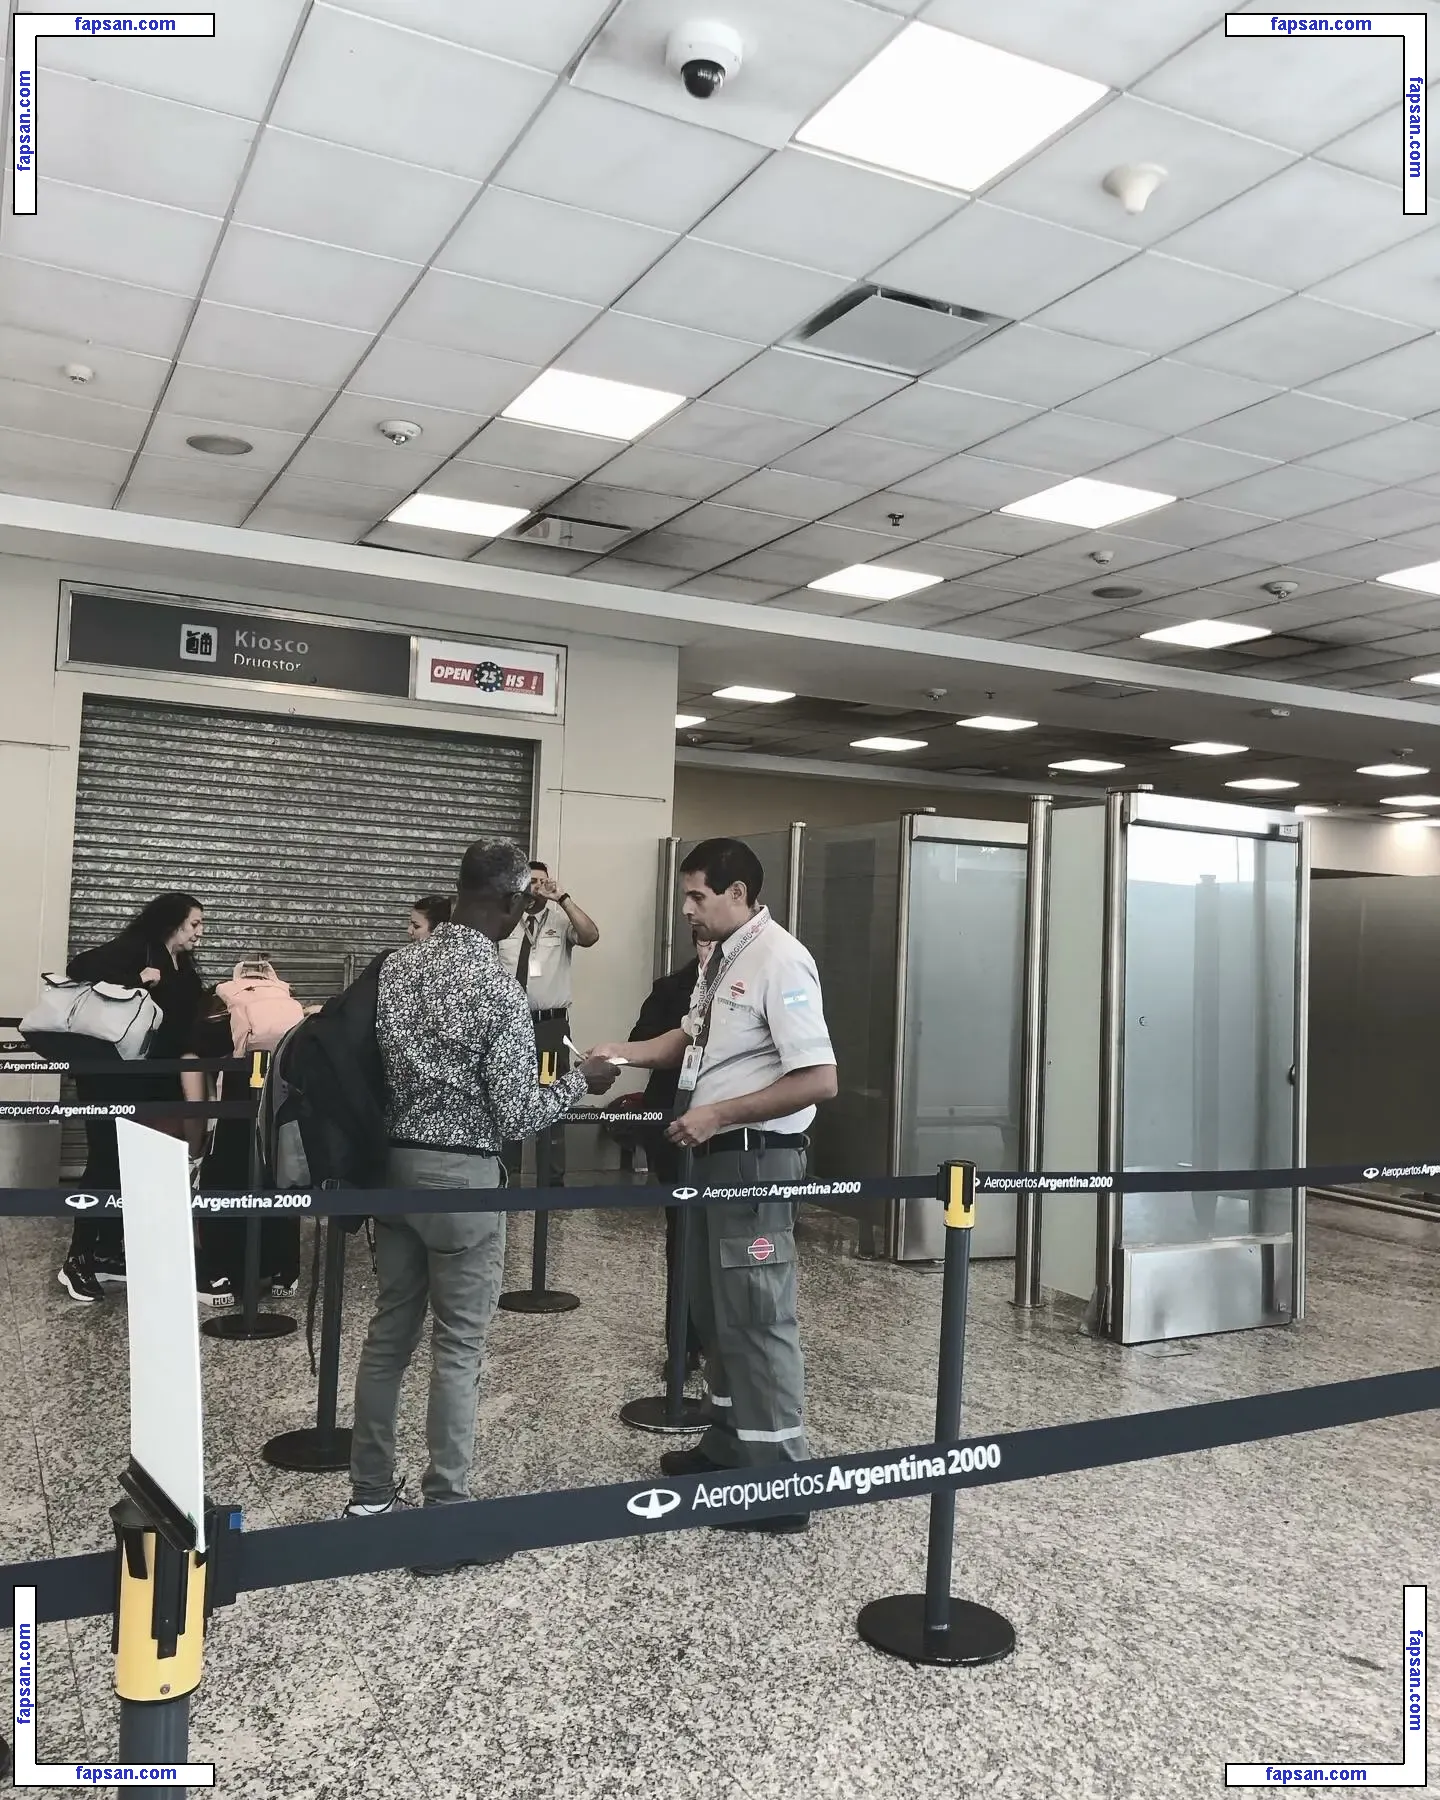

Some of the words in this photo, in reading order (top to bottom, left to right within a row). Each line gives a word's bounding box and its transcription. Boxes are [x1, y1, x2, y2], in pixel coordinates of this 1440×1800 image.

[235, 630, 309, 654] Kiosco
[433, 665, 472, 682] OPEN
[480, 670, 497, 683] 25
[505, 674, 525, 688] HS
[3, 1061, 48, 1072] Argentina
[48, 1061, 70, 1070] 2000
[0, 1105, 50, 1116] eropuertos
[51, 1104, 108, 1118] Argentina
[109, 1104, 136, 1115] 2000
[559, 1111, 599, 1122] eropuertos
[600, 1111, 642, 1122] Argentina
[642, 1111, 663, 1121] 2000
[1381, 1166, 1421, 1178] Aeropuertos
[702, 1185, 768, 1200] Aeropuertos
[768, 1182, 831, 1198] Argentina
[831, 1181, 861, 1194] 2000
[984, 1176, 1038, 1191] Aeropuertos
[1037, 1176, 1089, 1190] Argentina
[1089, 1176, 1113, 1188] 2000
[191, 1194, 272, 1212] Argentina
[274, 1194, 312, 1208] 2000
[214, 1297, 234, 1305] HUS
[692, 1472, 823, 1511] Aeropuertos
[826, 1455, 945, 1495] Argentina
[948, 1443, 1001, 1474] 2000
